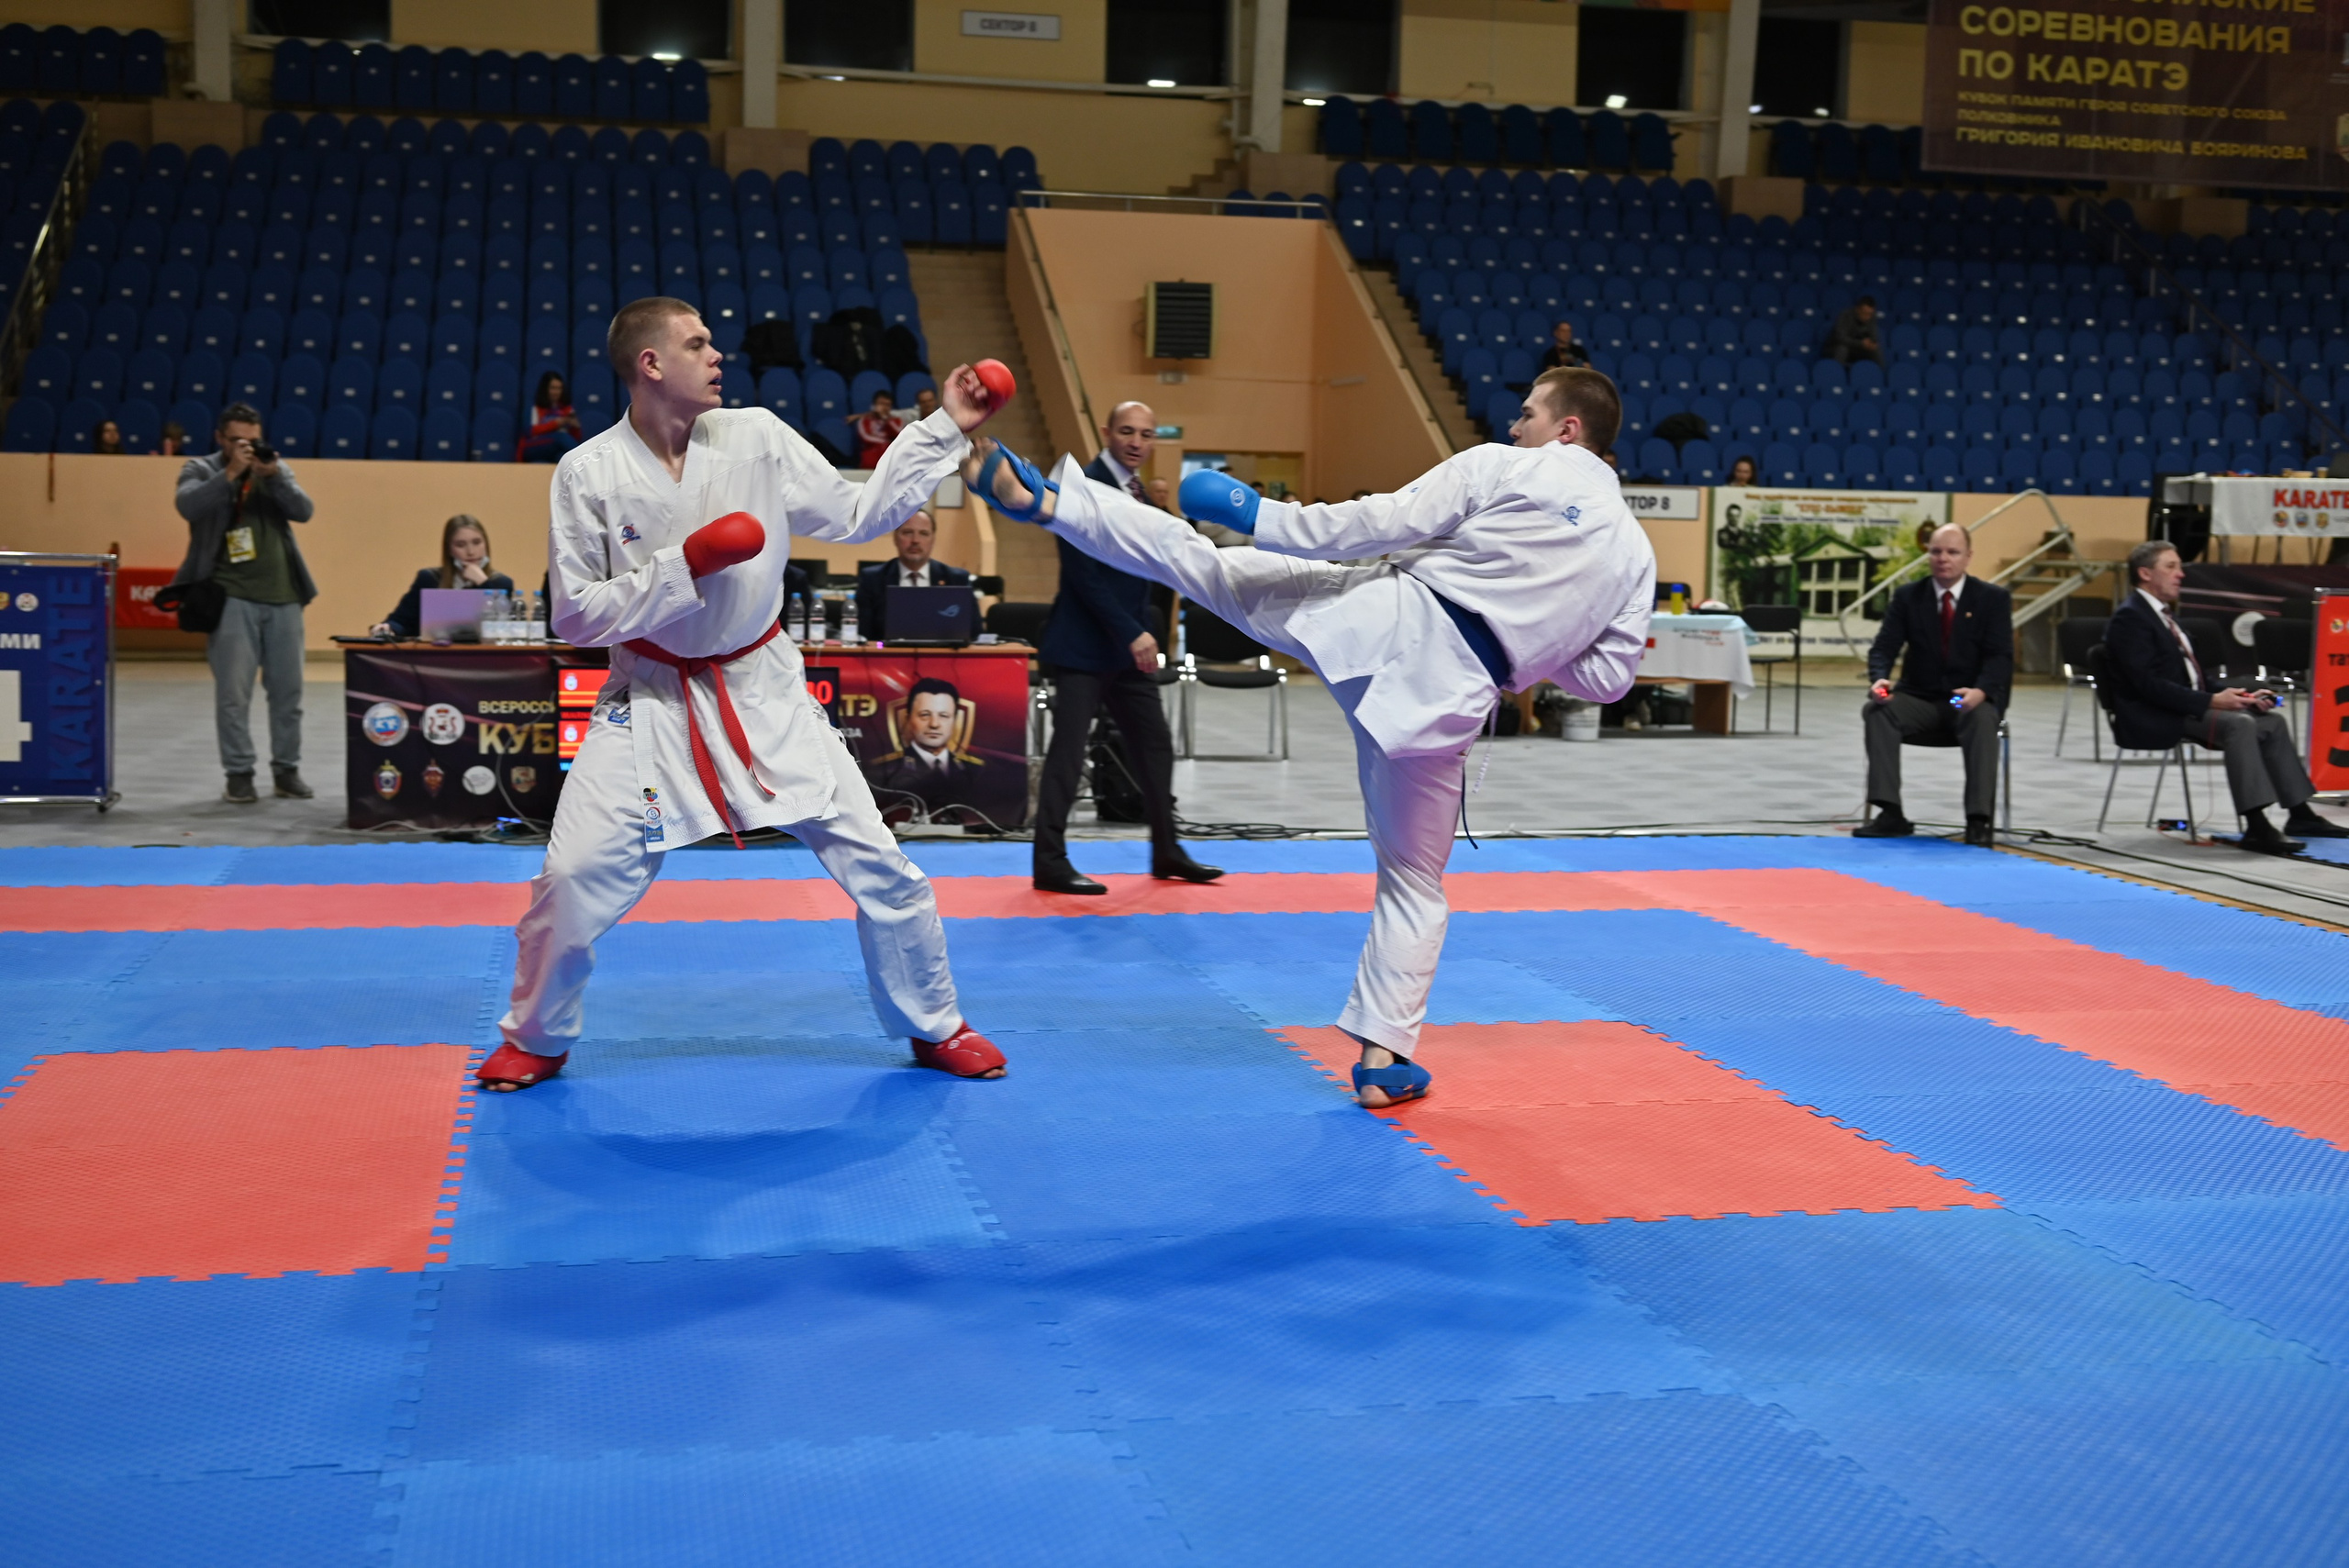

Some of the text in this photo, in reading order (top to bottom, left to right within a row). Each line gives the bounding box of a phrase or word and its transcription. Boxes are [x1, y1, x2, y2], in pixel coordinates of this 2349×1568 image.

[1960, 6, 2291, 54] СОРЕВНОВАНИЯ
[1958, 49, 2188, 91] ПО КАРАТЭ
[2131, 102, 2230, 118] СОВЕТСКОГО
[1955, 127, 2309, 161] ГРИГОРИЯ ИВАНОВИЧА БОЯРИНОВА
[1622, 495, 1658, 510] ТОР
[2273, 487, 2349, 510] KARATE
[48, 575, 93, 781] KARATE
[478, 722, 556, 754] КУБ
